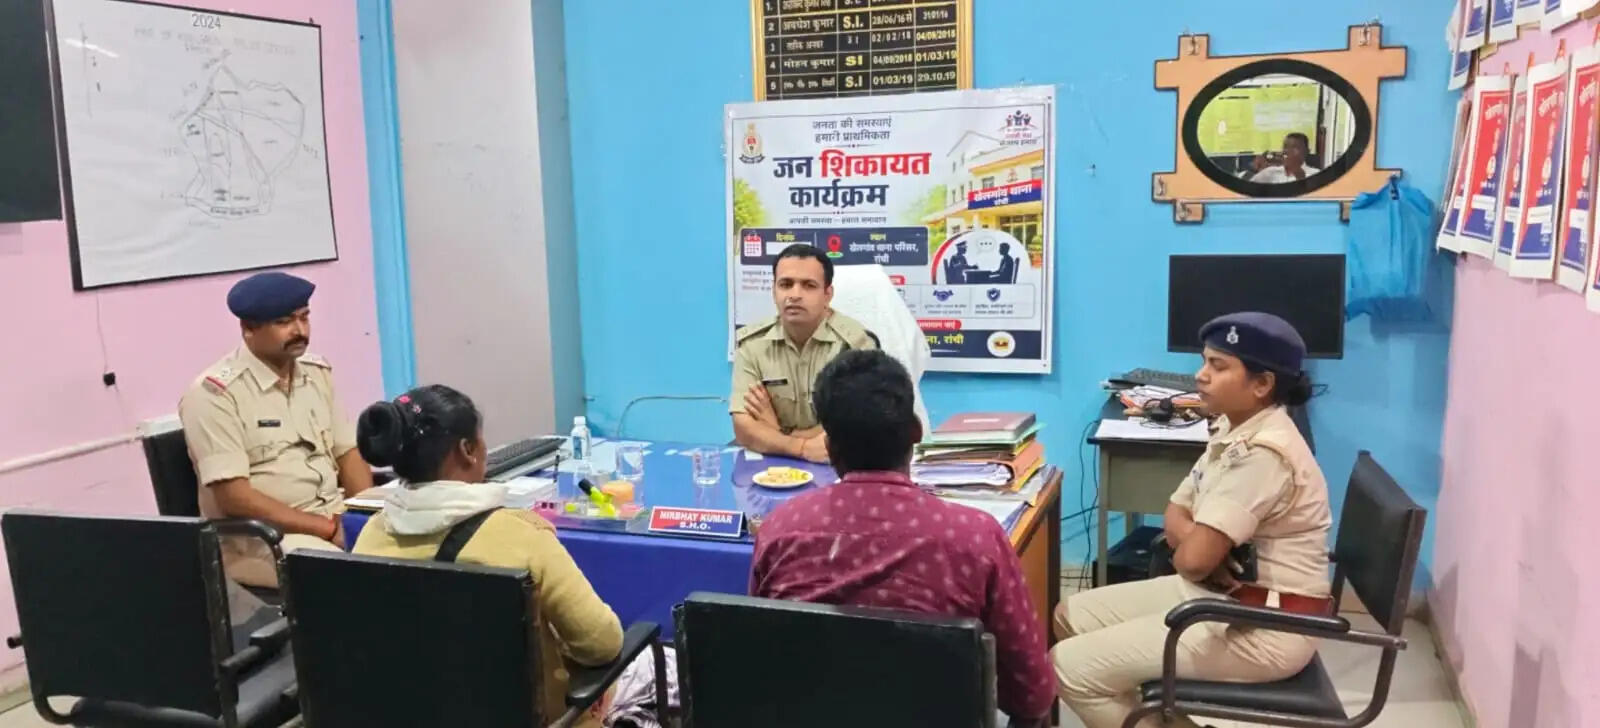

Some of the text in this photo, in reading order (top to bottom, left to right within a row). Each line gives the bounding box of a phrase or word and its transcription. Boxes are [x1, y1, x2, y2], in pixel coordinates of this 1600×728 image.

[192, 13, 222, 30] 2024
[768, 22, 775, 31] 2
[812, 18, 835, 32] कुमार
[843, 15, 863, 29] S.I.
[845, 55, 862, 67] SI
[915, 50, 957, 62] 01/03/19
[770, 61, 776, 70] 4
[784, 57, 835, 70] मोहन कुमार
[873, 75, 913, 85] 01/03/19
[918, 71, 955, 82] 29.10.19
[770, 81, 776, 90] 5
[812, 115, 892, 129] जनता की समस्याएं
[843, 129, 890, 142] प्राथमिकता
[772, 149, 932, 178] जन शिकायत
[788, 178, 890, 209] कार्यक्रम
[1010, 184, 1033, 195] थाना
[874, 254, 889, 264] रांची
[944, 332, 964, 345] रांची
[700, 513, 733, 525] KUMAR
